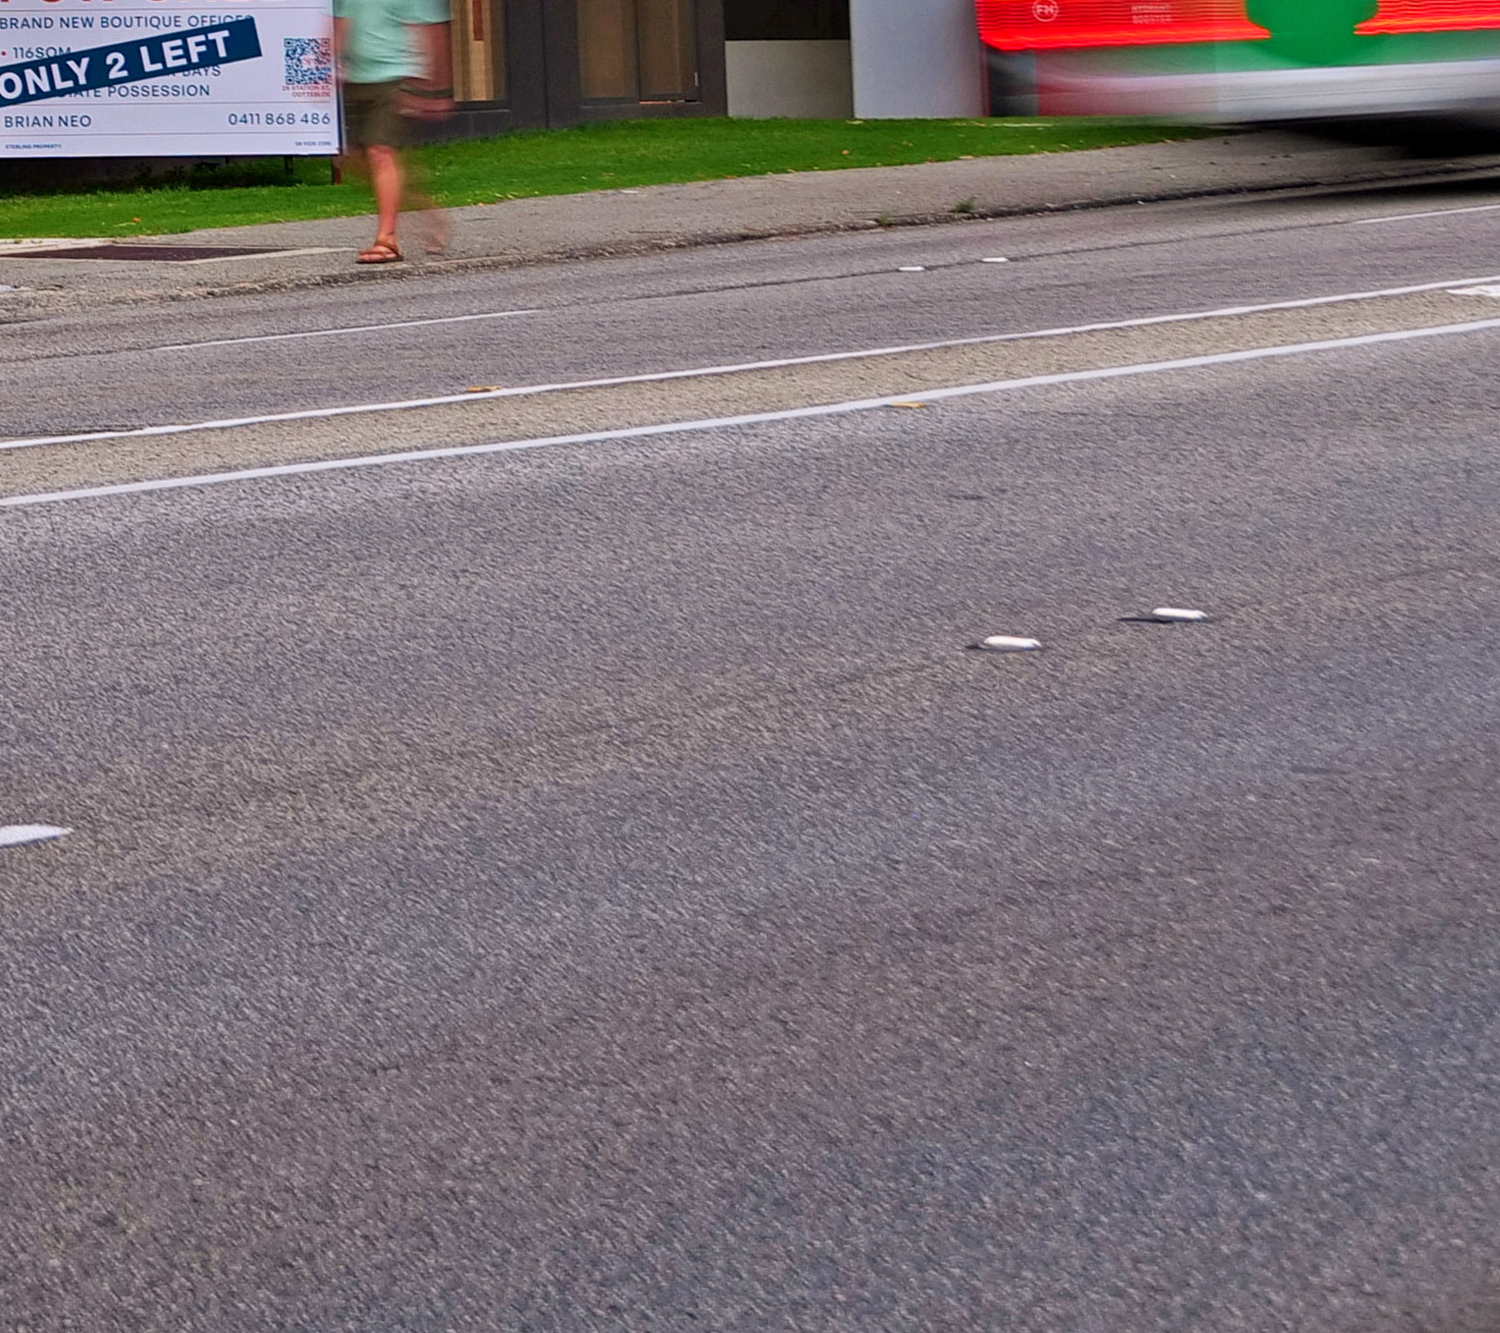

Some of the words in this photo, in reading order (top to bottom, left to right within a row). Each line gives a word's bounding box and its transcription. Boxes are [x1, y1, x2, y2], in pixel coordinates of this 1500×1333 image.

[0, 17, 54, 30] BRAND
[59, 16, 95, 29] NEW
[100, 15, 182, 30] BOUTIQUE
[187, 14, 252, 27] OFFIC
[105, 51, 129, 80] 2
[139, 29, 231, 73] LEFT
[107, 84, 210, 98] POSSESSION
[4, 115, 53, 128] BRIAN
[58, 115, 92, 128] NEO
[228, 113, 260, 125] 0411
[265, 113, 296, 125] 868
[300, 113, 331, 125] 486
